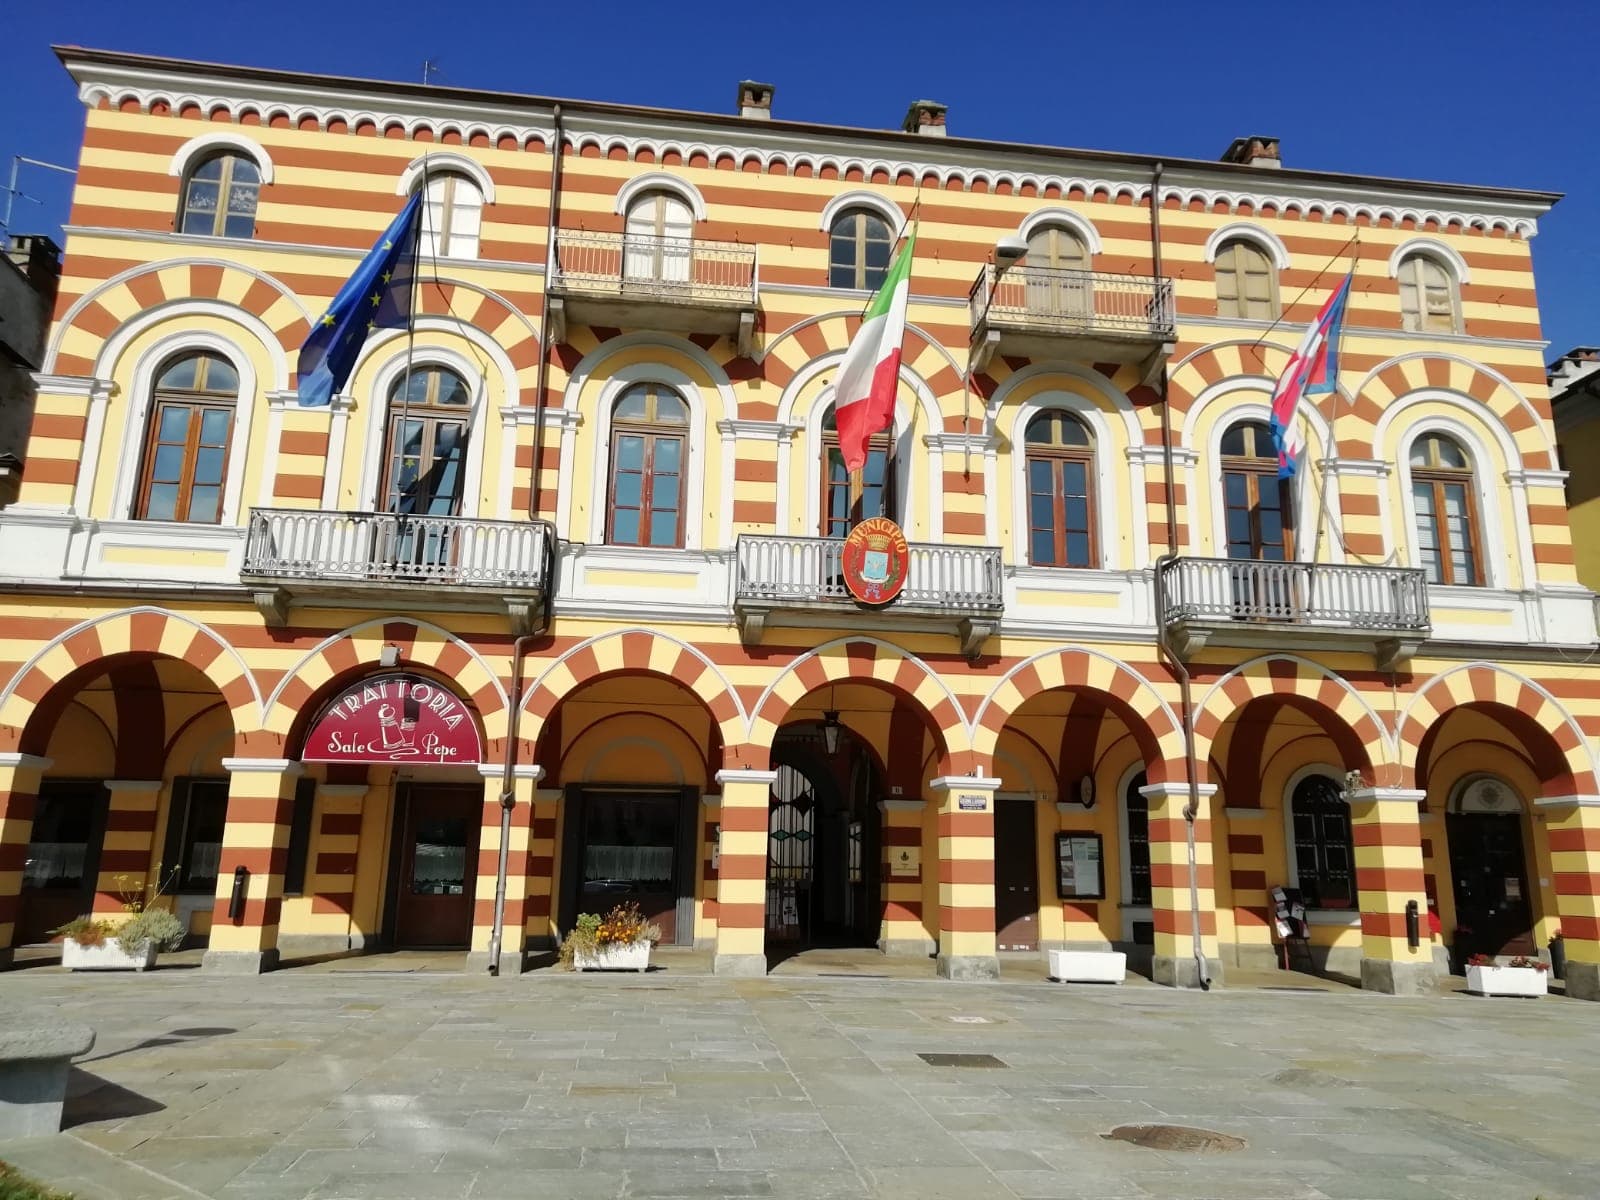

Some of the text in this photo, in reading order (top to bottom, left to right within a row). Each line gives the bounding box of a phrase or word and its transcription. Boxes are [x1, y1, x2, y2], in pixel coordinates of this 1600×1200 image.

[849, 519, 907, 554] MUNICIPIO
[328, 679, 464, 730] TRATTORIA
[327, 730, 457, 763] Sale Pepe
